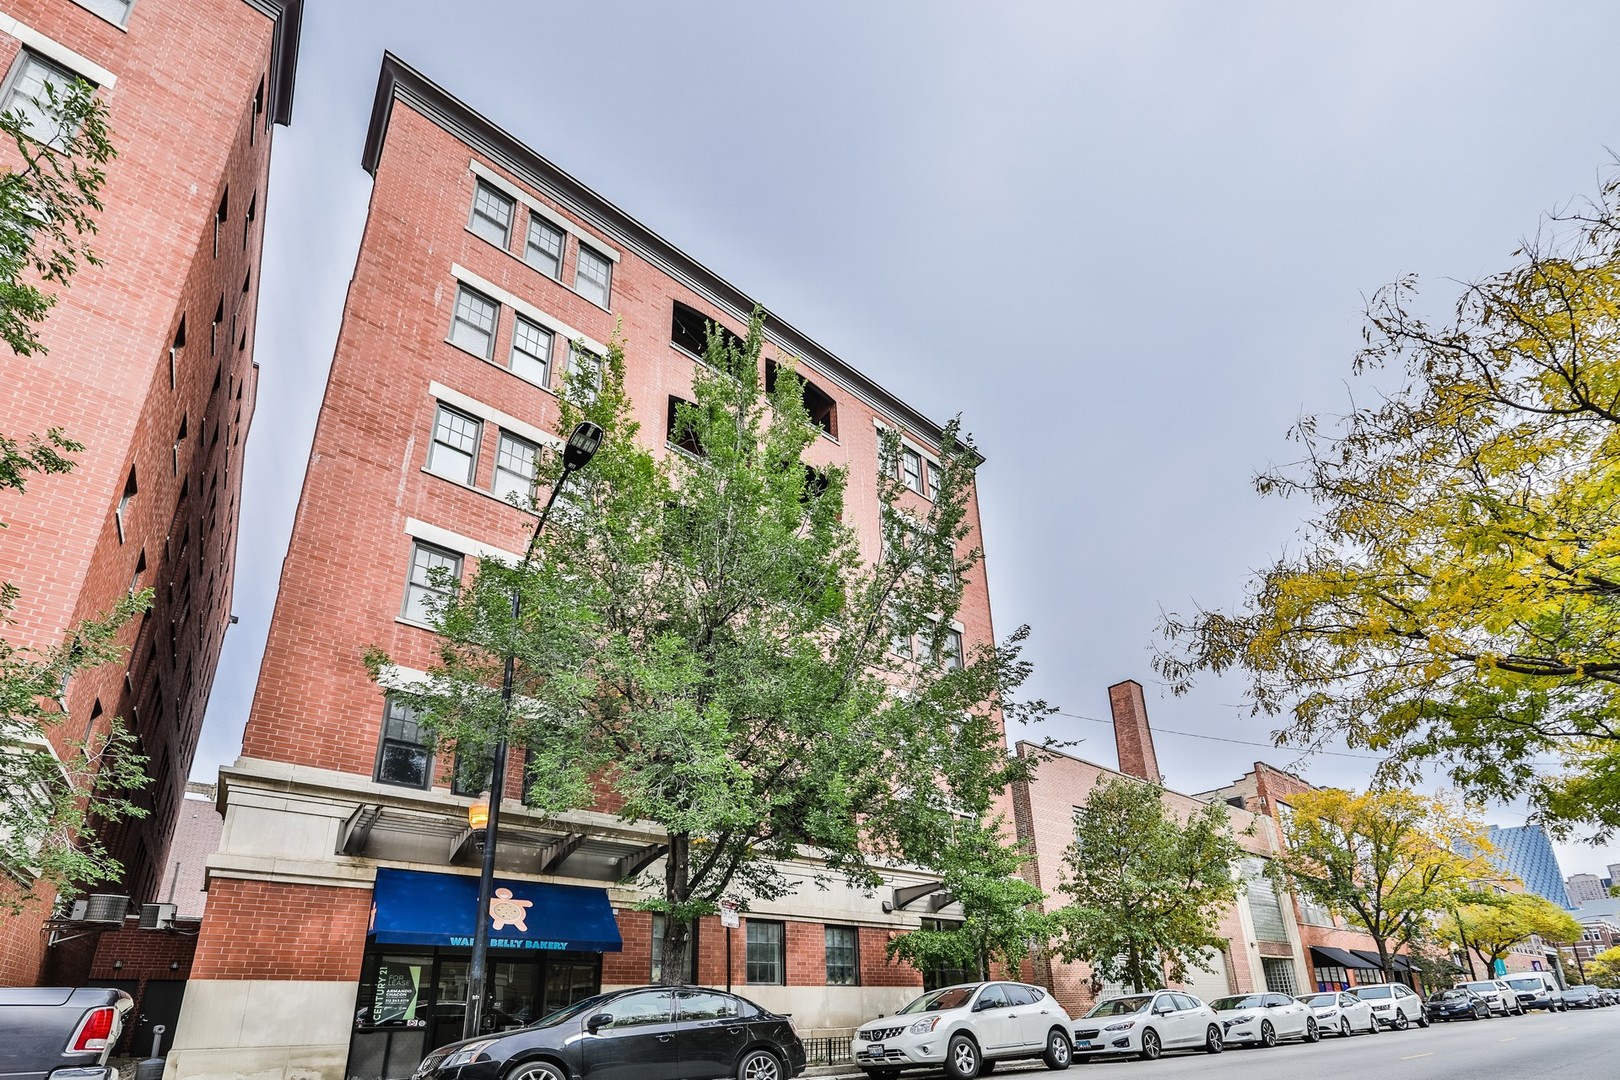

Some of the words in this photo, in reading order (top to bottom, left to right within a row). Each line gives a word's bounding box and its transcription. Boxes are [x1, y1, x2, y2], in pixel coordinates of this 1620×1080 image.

[490, 938, 524, 948] BELLY
[525, 940, 569, 950] BAKERY
[379, 966, 388, 975] 21
[373, 976, 387, 1021] CENTURY
